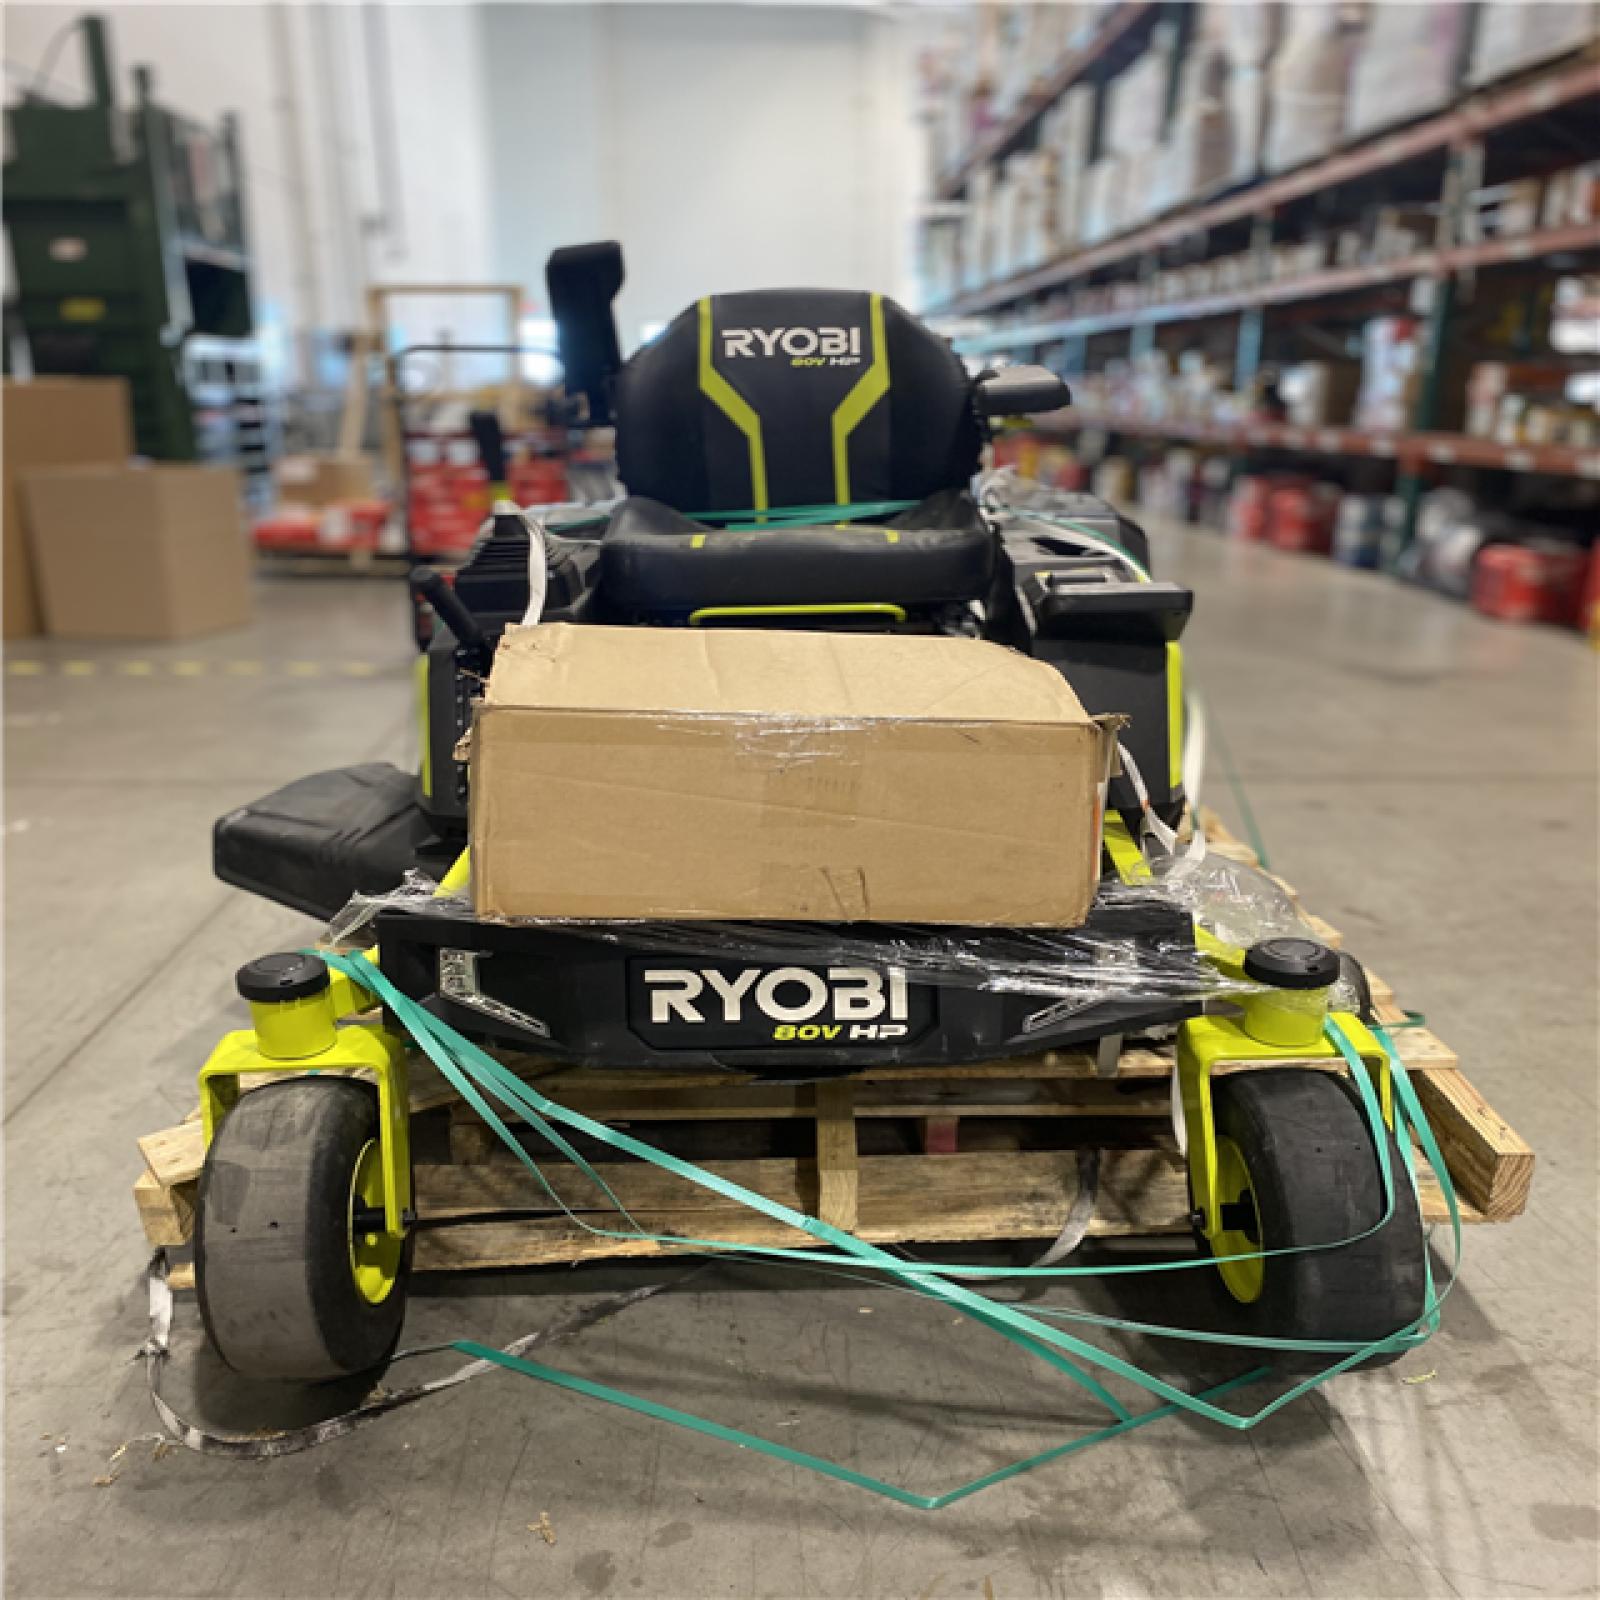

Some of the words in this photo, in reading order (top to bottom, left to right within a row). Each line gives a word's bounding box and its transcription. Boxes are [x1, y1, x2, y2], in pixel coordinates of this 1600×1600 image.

[721, 327, 861, 358] RYOBI
[644, 967, 908, 1023] RYOBI
[772, 1024, 843, 1040] 80V
[849, 1024, 908, 1039] HP
